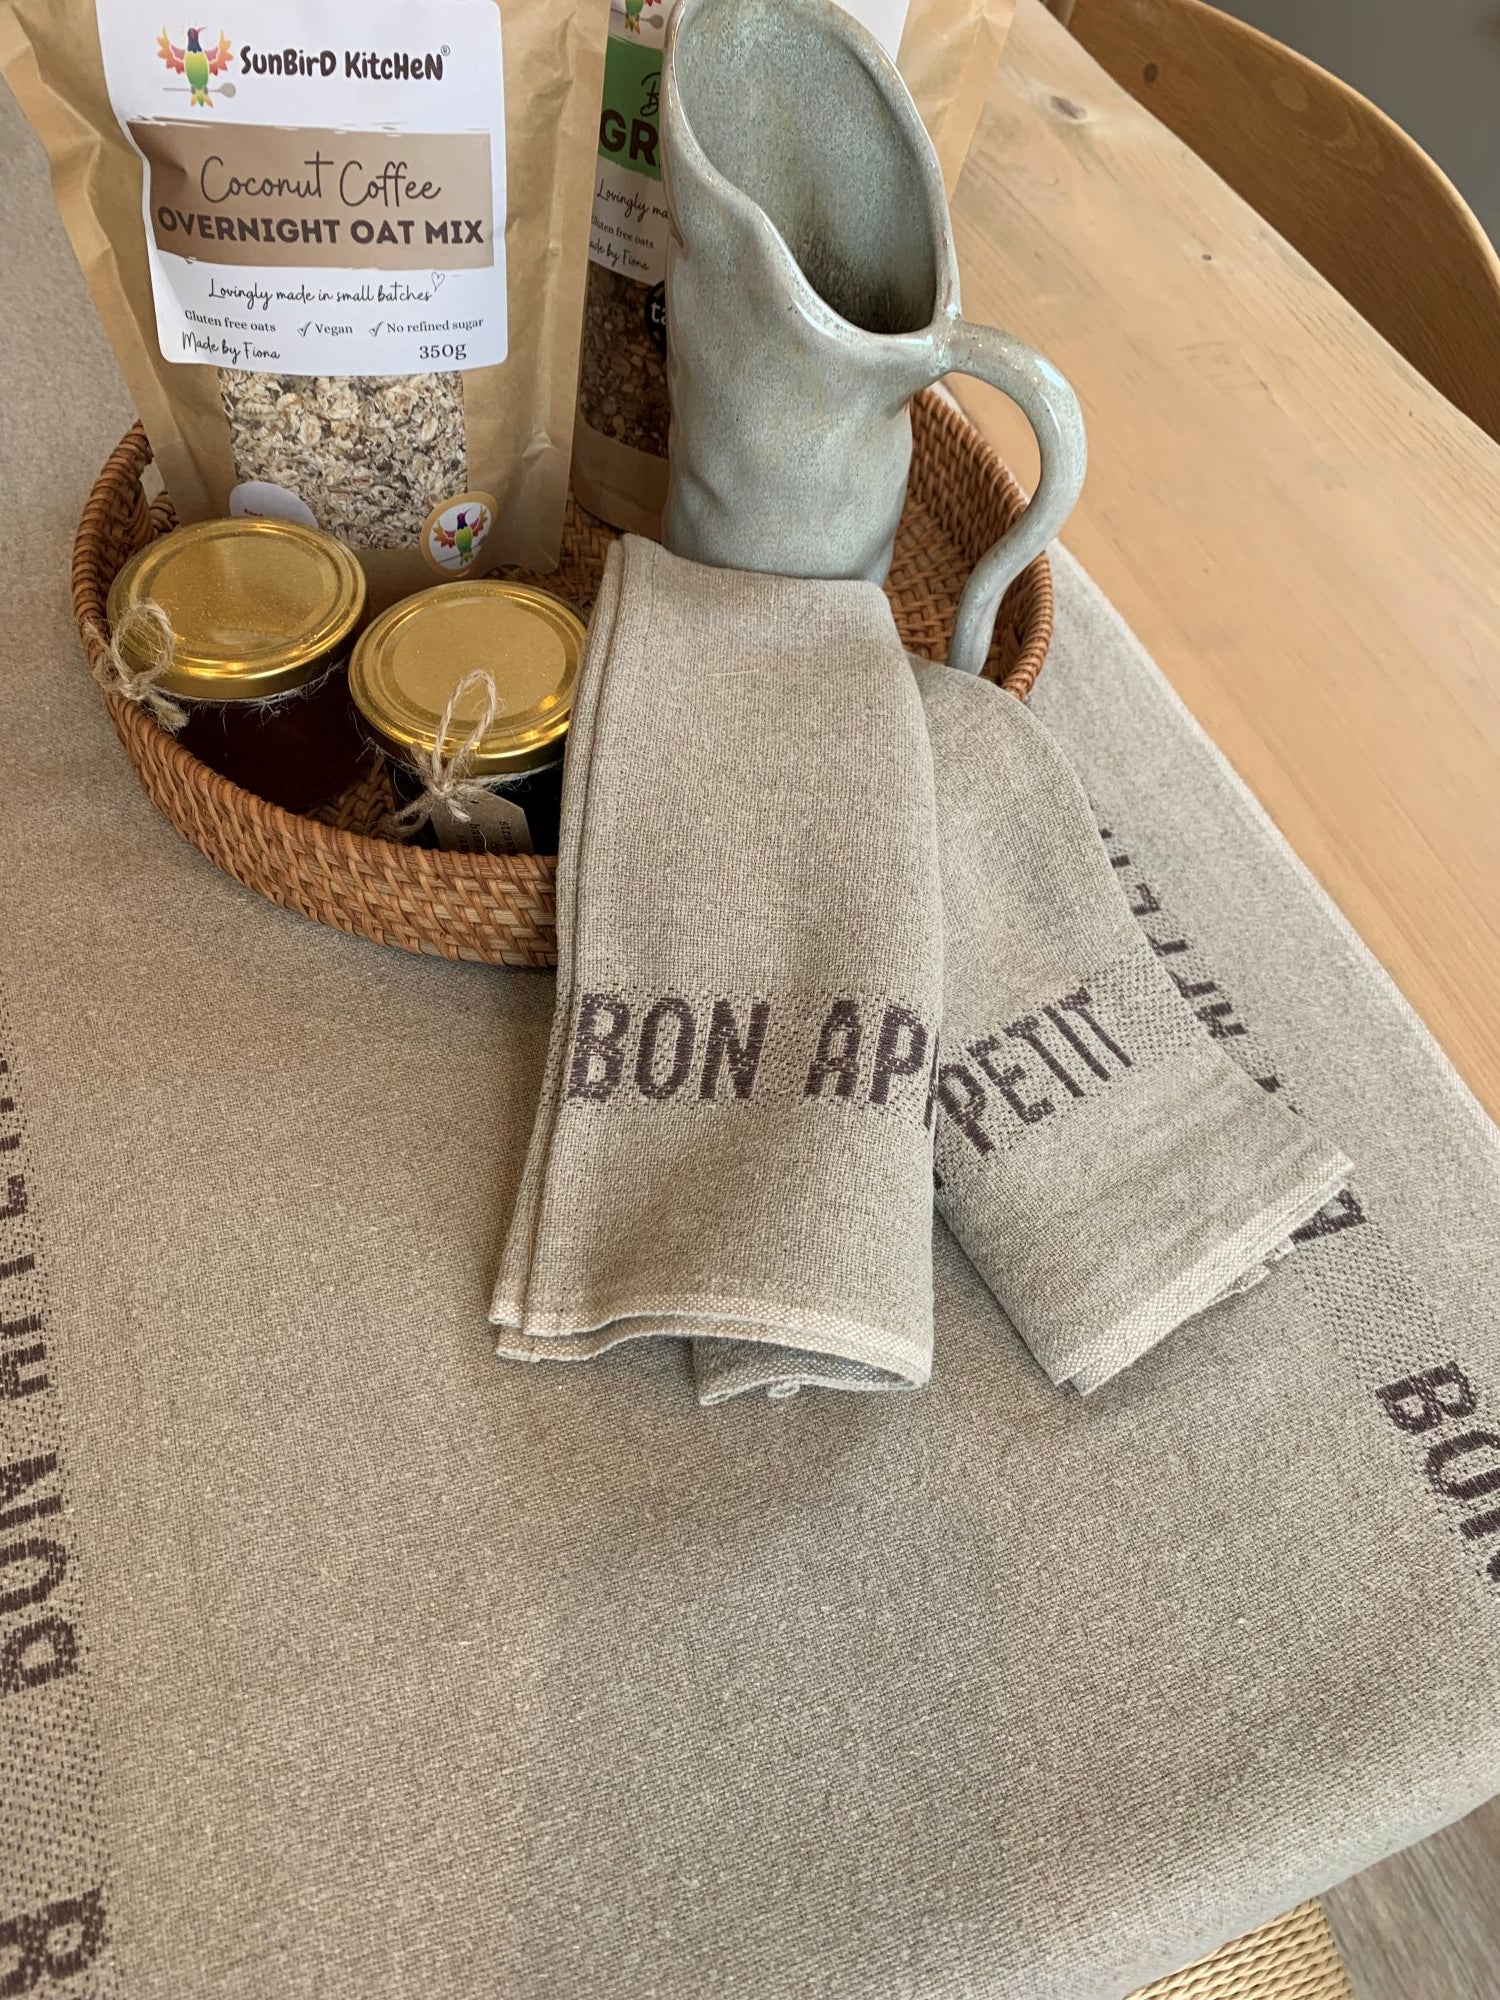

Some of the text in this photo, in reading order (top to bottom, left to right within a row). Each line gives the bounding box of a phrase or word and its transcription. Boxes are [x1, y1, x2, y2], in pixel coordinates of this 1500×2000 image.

[600, 108, 661, 169] GR
[201, 150, 441, 207] Coconut Coffee
[597, 178, 670, 223] Lovingly ma
[157, 206, 485, 244] OVERNIGHT OAT MIX
[616, 226, 634, 241] free
[635, 235, 655, 249] oats
[606, 242, 620, 267] by
[622, 249, 650, 271] Fiona
[208, 278, 432, 311] Lovingly made in small batches
[184, 309, 276, 333] Gluten free oats
[314, 323, 353, 337] Vegan
[387, 318, 484, 334] No refined sugar
[182, 331, 281, 365] Made by Fiona
[419, 343, 467, 361] 350g
[568, 994, 940, 1131] BON AP
